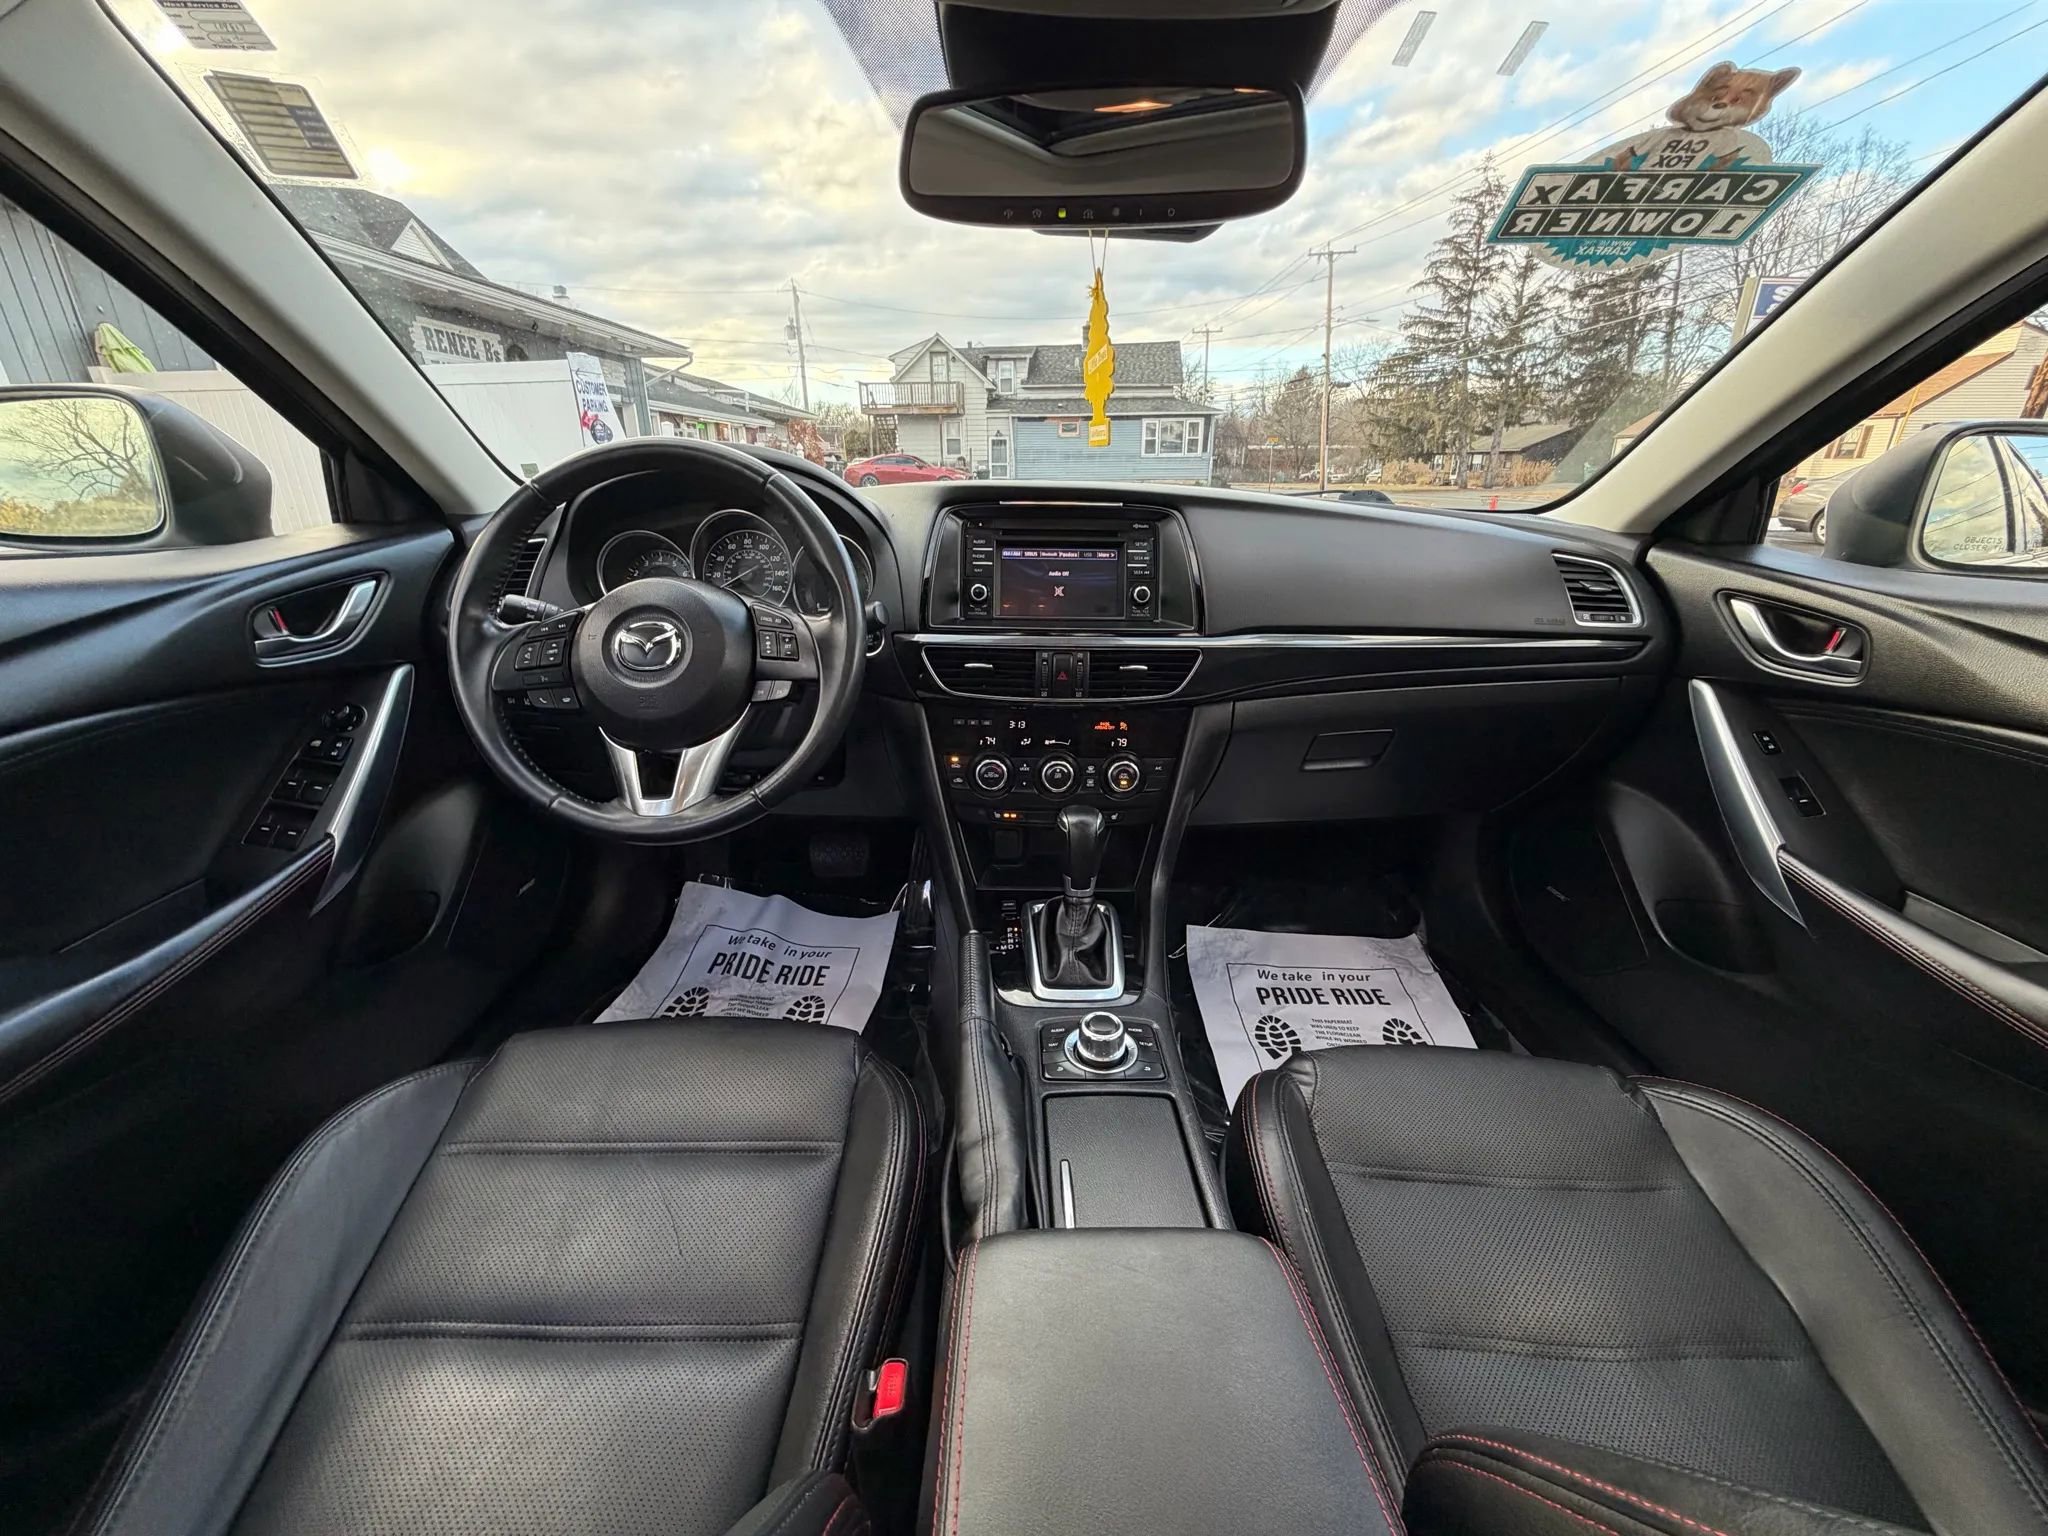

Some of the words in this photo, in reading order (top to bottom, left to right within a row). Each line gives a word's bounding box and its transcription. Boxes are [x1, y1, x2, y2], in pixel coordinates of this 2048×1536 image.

[582, 398, 609, 412] PARKING
[1953, 543, 1988, 551] CLOSER
[1964, 536, 2003, 544] OBJECTS
[985, 736, 996, 745] 74
[1117, 738, 1127, 747] 79
[747, 934, 776, 950] take
[783, 946, 798, 957] in
[800, 950, 832, 960] your
[707, 952, 775, 984] PRIDE
[774, 965, 831, 986] RIDE
[1257, 969, 1278, 980] We
[1282, 971, 1312, 981] take
[1322, 971, 1335, 981] in
[1338, 973, 1370, 983] your
[1255, 986, 1330, 1005] PRIDE
[1330, 988, 1392, 1006] RIDE
